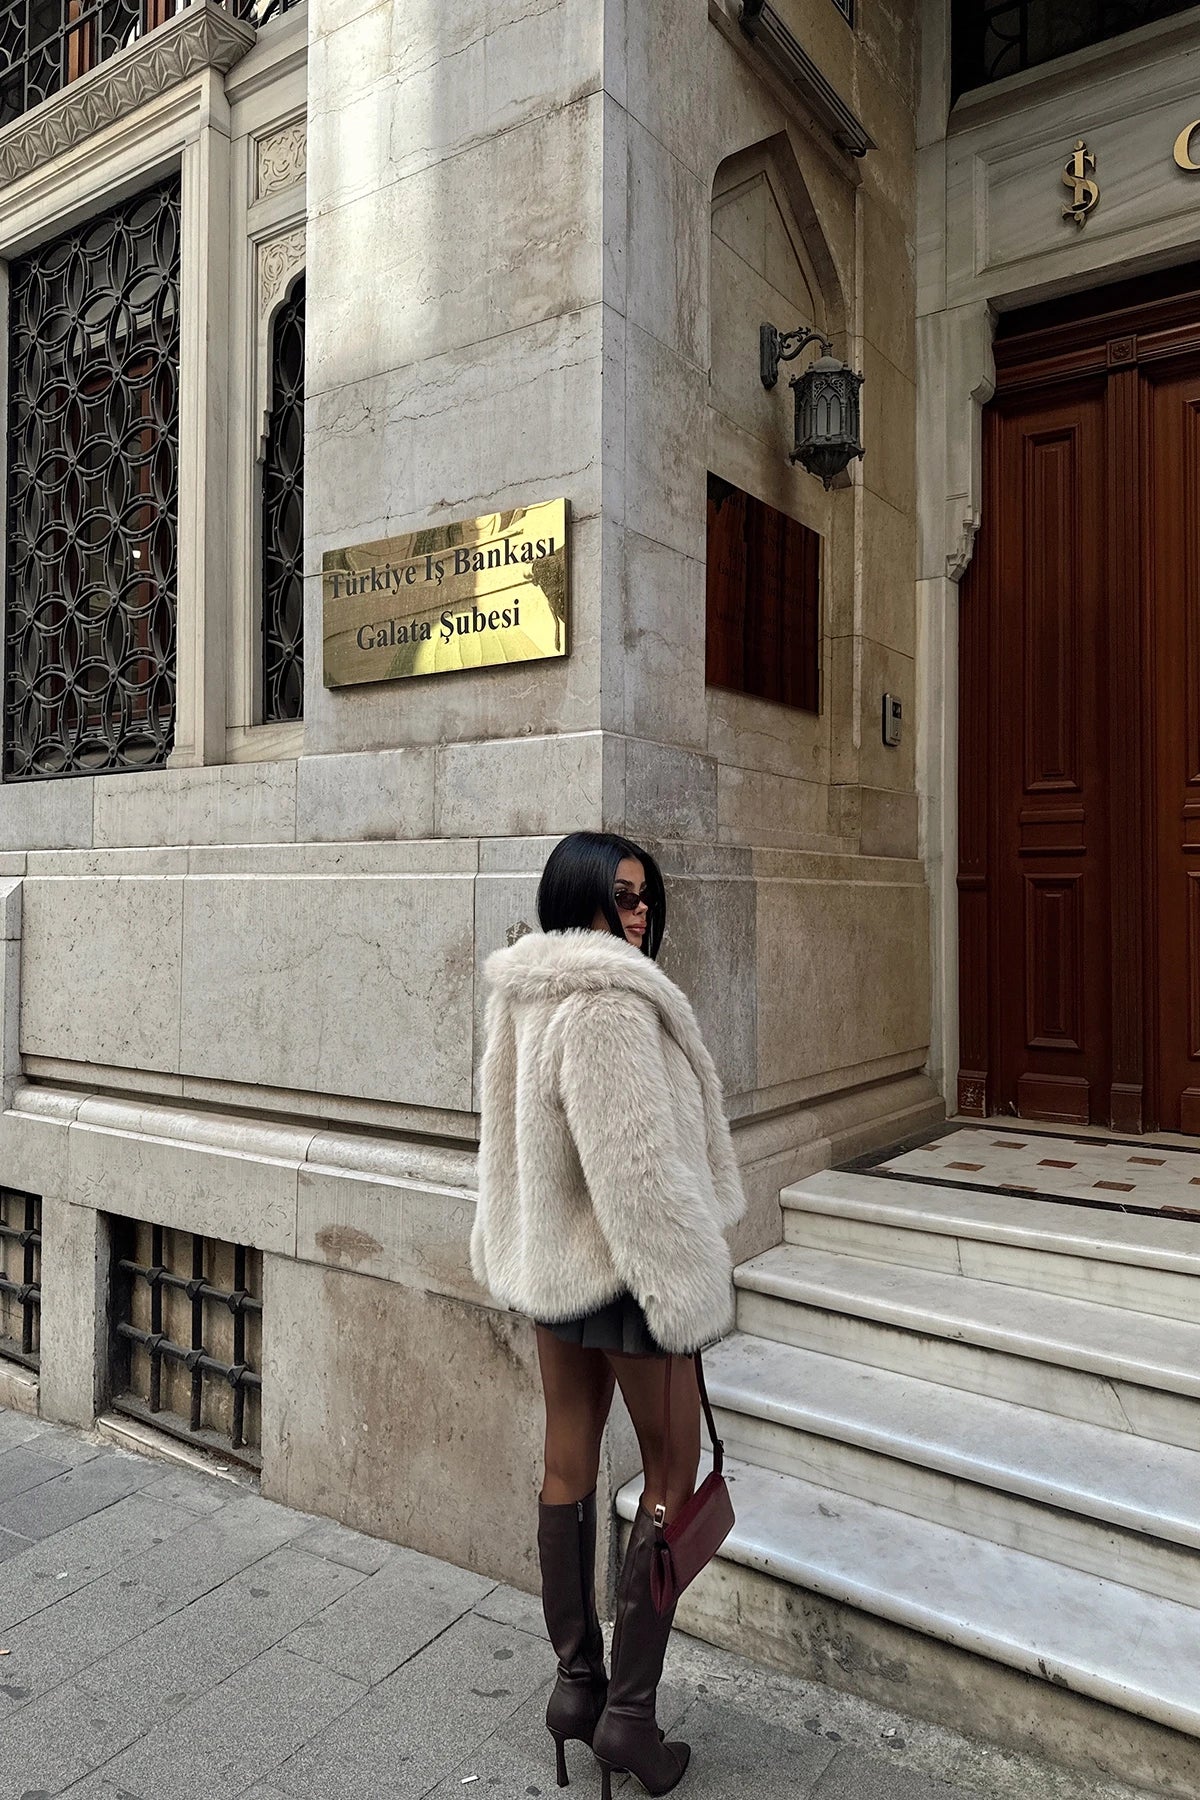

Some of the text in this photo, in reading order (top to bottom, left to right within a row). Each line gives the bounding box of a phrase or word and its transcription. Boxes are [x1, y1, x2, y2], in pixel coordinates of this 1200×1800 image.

[329, 562, 417, 599] Türkiye
[453, 537, 556, 576] Bankası
[357, 598, 521, 651] Galata Şubesi
